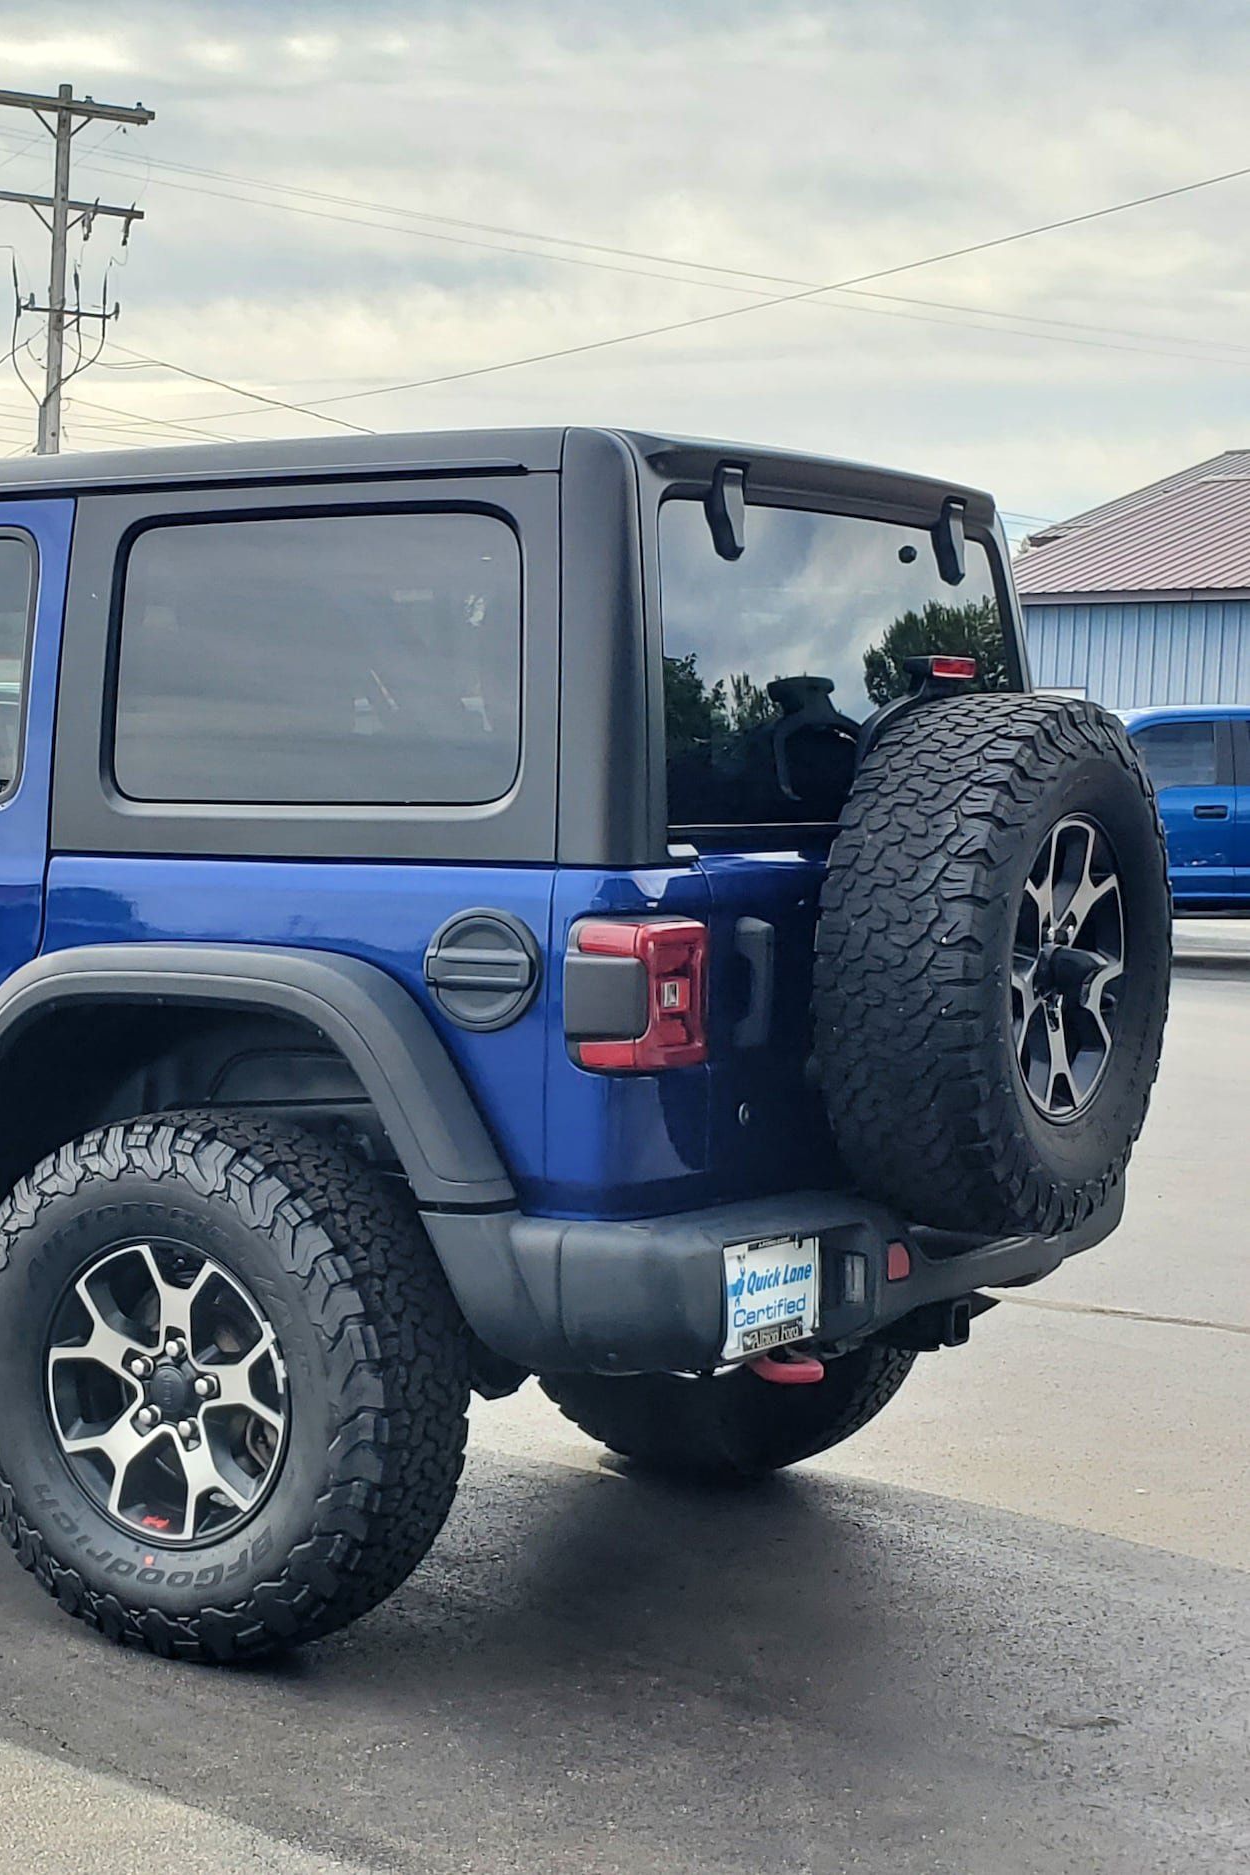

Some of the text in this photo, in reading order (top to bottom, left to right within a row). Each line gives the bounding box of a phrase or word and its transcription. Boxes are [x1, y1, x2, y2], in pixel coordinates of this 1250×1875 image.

[746, 1263, 813, 1294] Quick Lane
[733, 1293, 807, 1328] Certified
[33, 1483, 274, 1589] BFGoodrich
